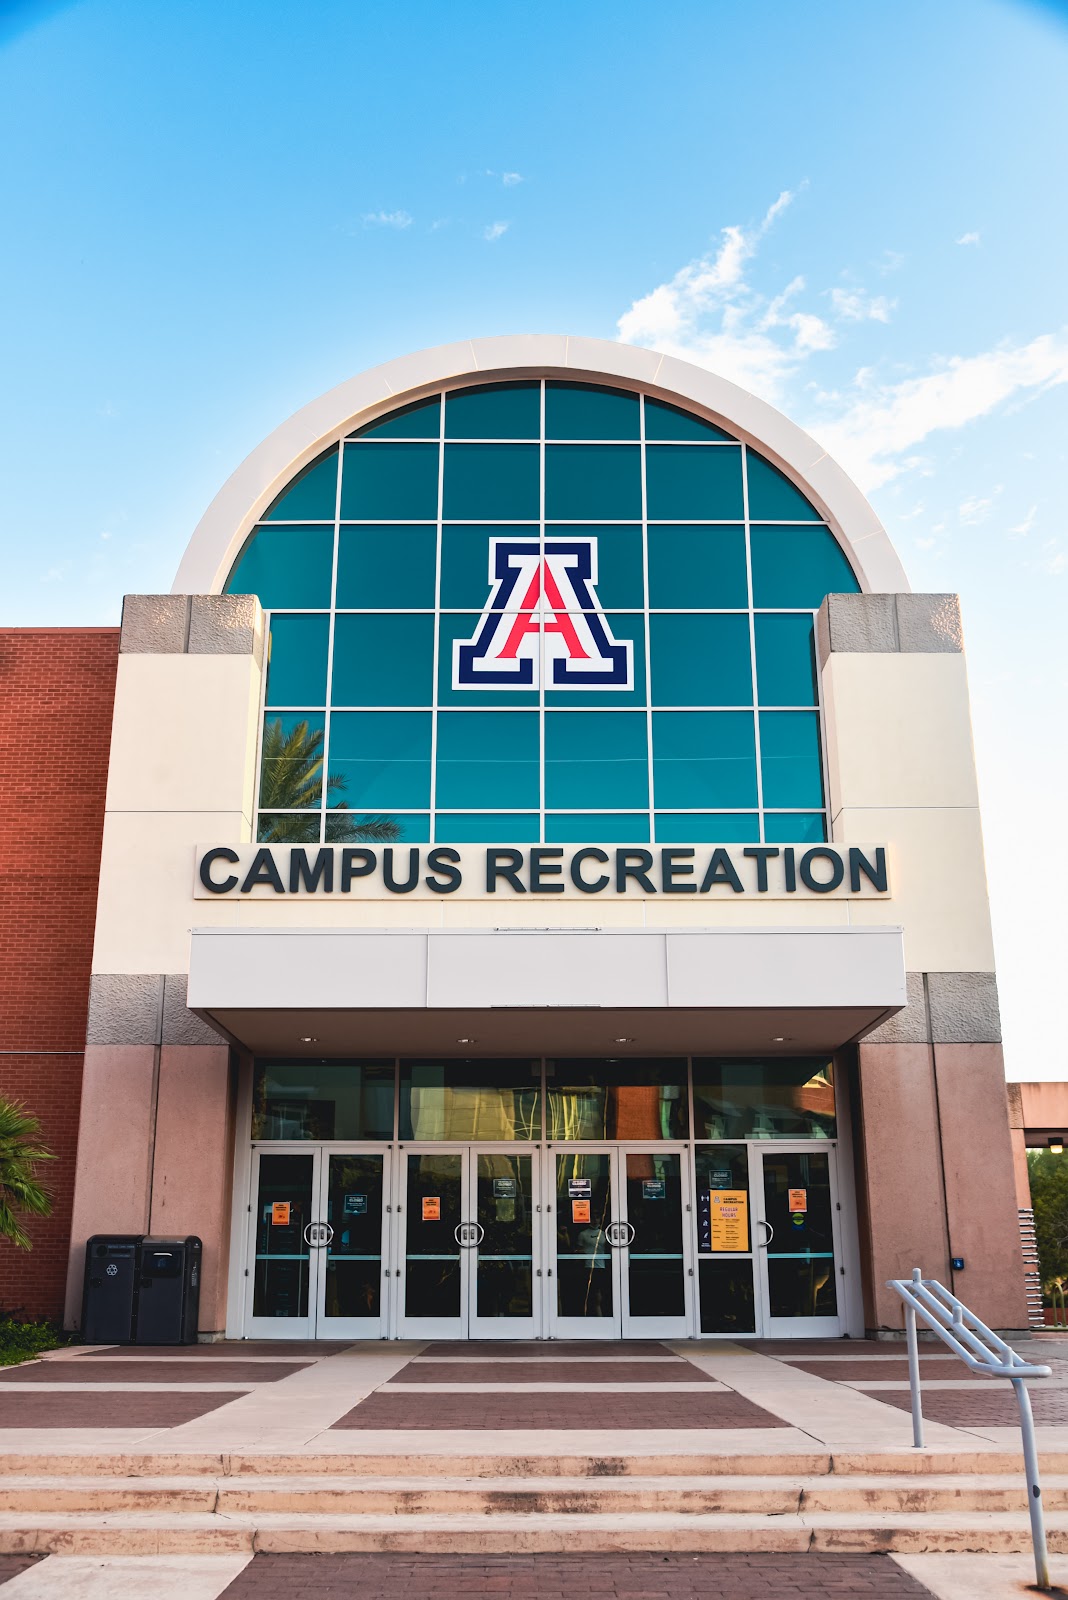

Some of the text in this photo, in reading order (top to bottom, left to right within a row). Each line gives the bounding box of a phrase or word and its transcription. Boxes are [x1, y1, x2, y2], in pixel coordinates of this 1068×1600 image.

[452, 537, 634, 691] A
[199, 847, 888, 893] CAMPUS RECREATION
